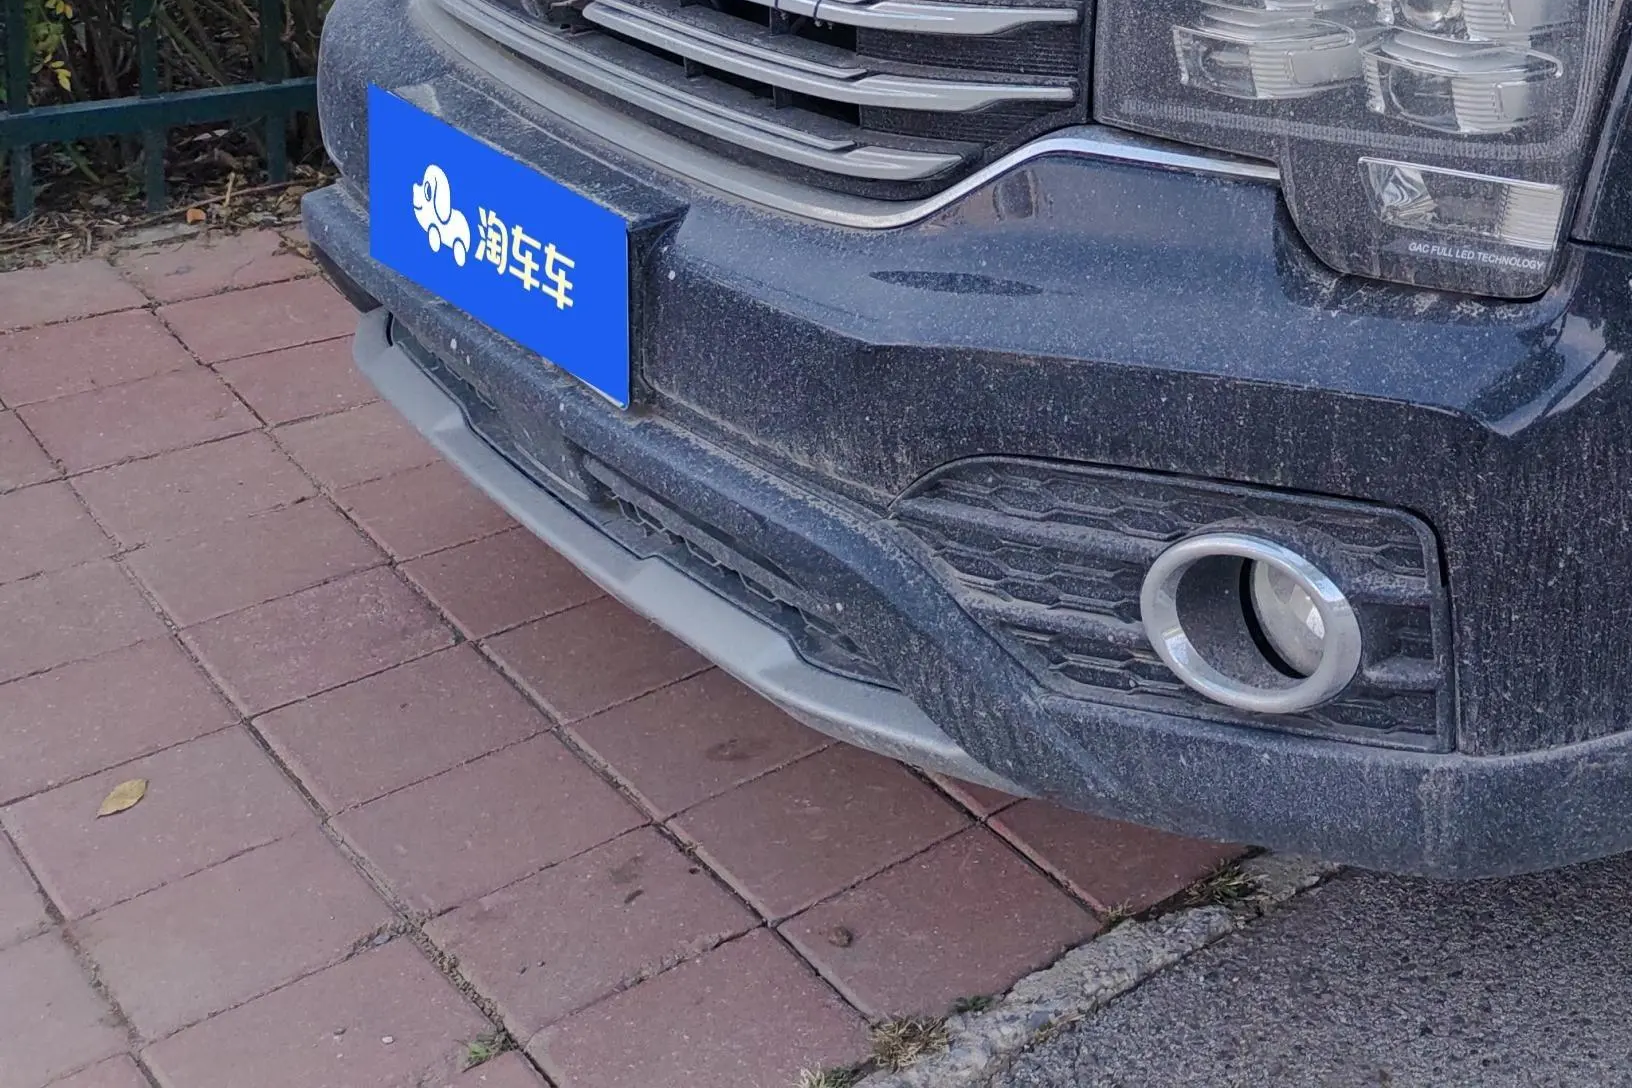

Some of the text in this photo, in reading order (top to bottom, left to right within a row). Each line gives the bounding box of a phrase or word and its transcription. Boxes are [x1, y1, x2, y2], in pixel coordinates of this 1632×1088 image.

[1408, 241, 1545, 270] GAC FULL LED TECHNOLOGY
